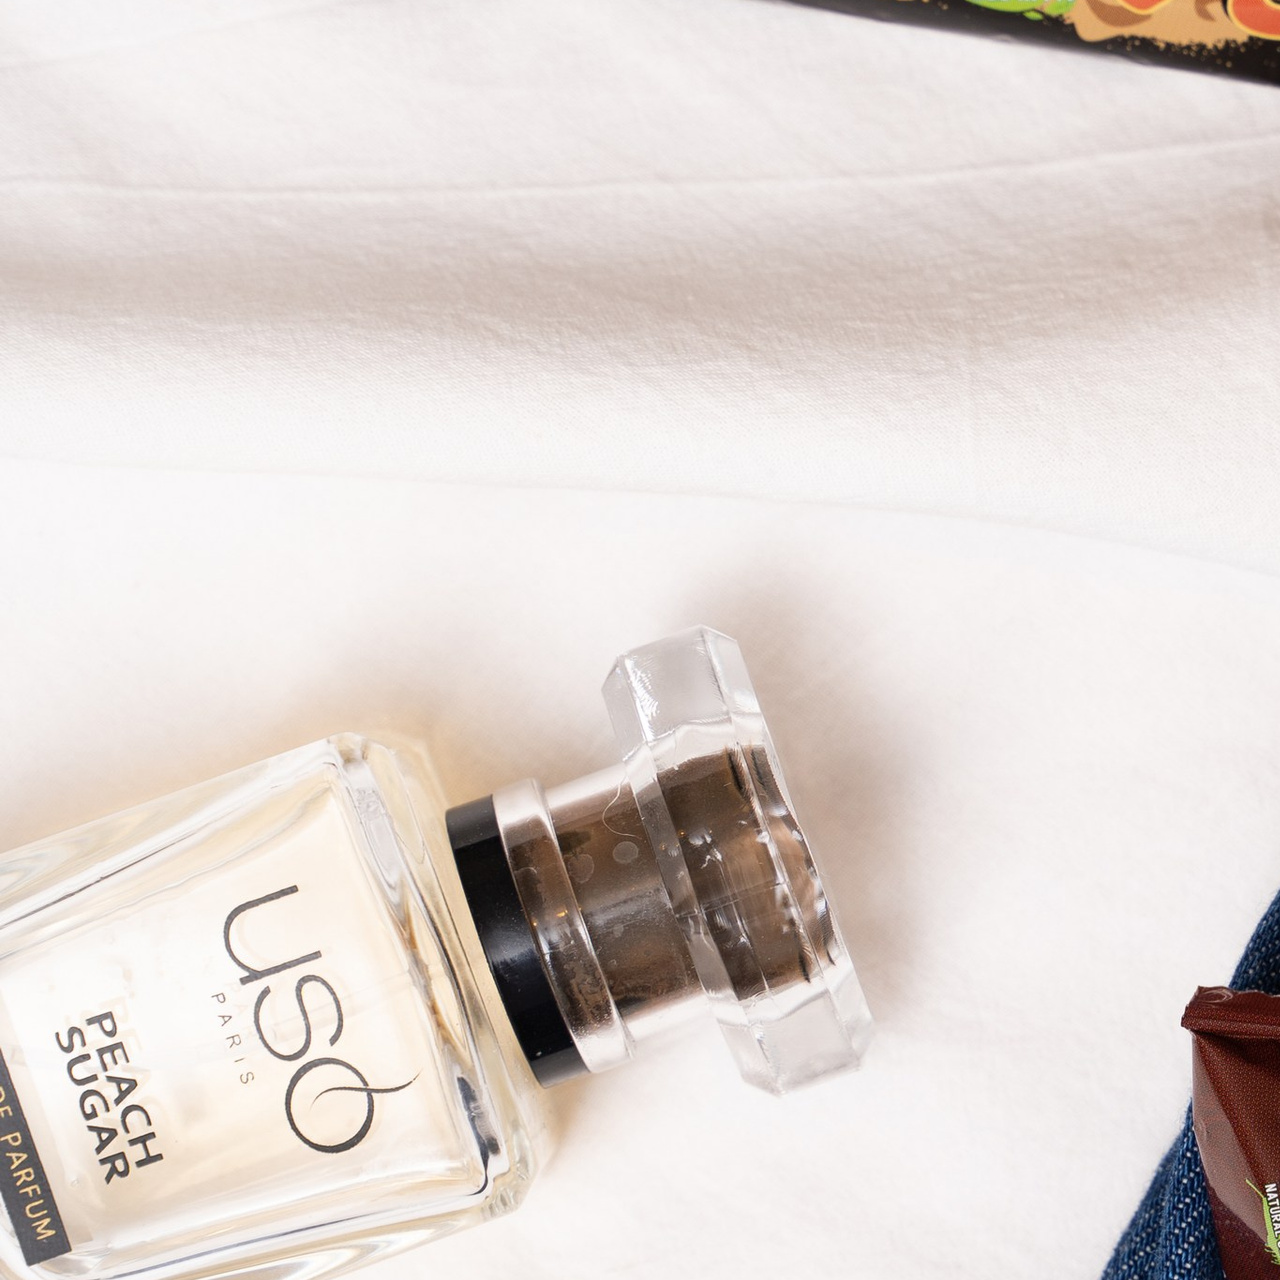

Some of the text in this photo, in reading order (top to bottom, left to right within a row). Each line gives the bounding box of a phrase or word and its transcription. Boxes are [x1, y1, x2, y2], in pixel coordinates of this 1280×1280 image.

[86, 1011, 163, 1168] PEACH
[211, 992, 254, 1084] PARIS
[55, 1026, 130, 1184] SUGAR
[1, 1132, 56, 1240] PARFUM
